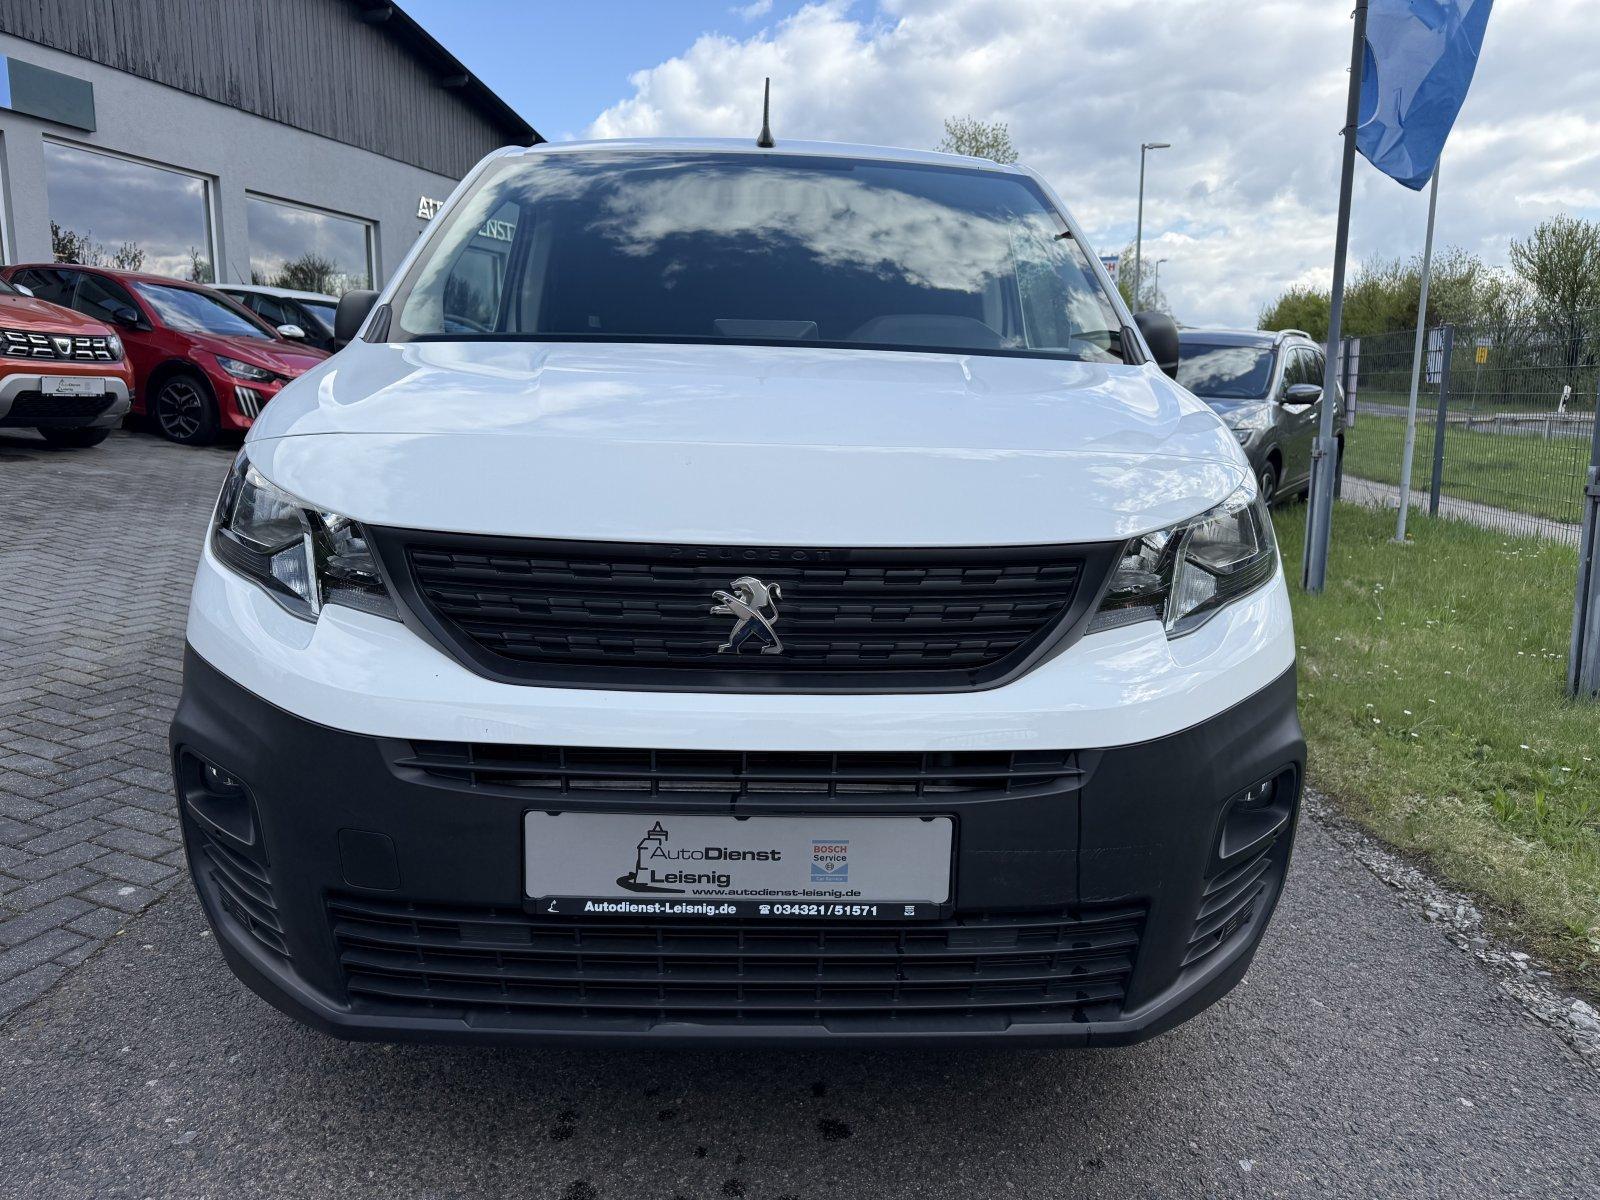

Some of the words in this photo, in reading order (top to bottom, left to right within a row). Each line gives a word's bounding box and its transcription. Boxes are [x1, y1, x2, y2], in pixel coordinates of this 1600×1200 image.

[650, 846, 781, 861] AutoDienst
[813, 845, 847, 853] BOSCH
[650, 869, 731, 888] Leisnig
[692, 888, 862, 899] www.autodienst-leisnig.de
[584, 900, 737, 916] Autodienst-Leisnig.de
[773, 904, 878, 916] 034321/51571
